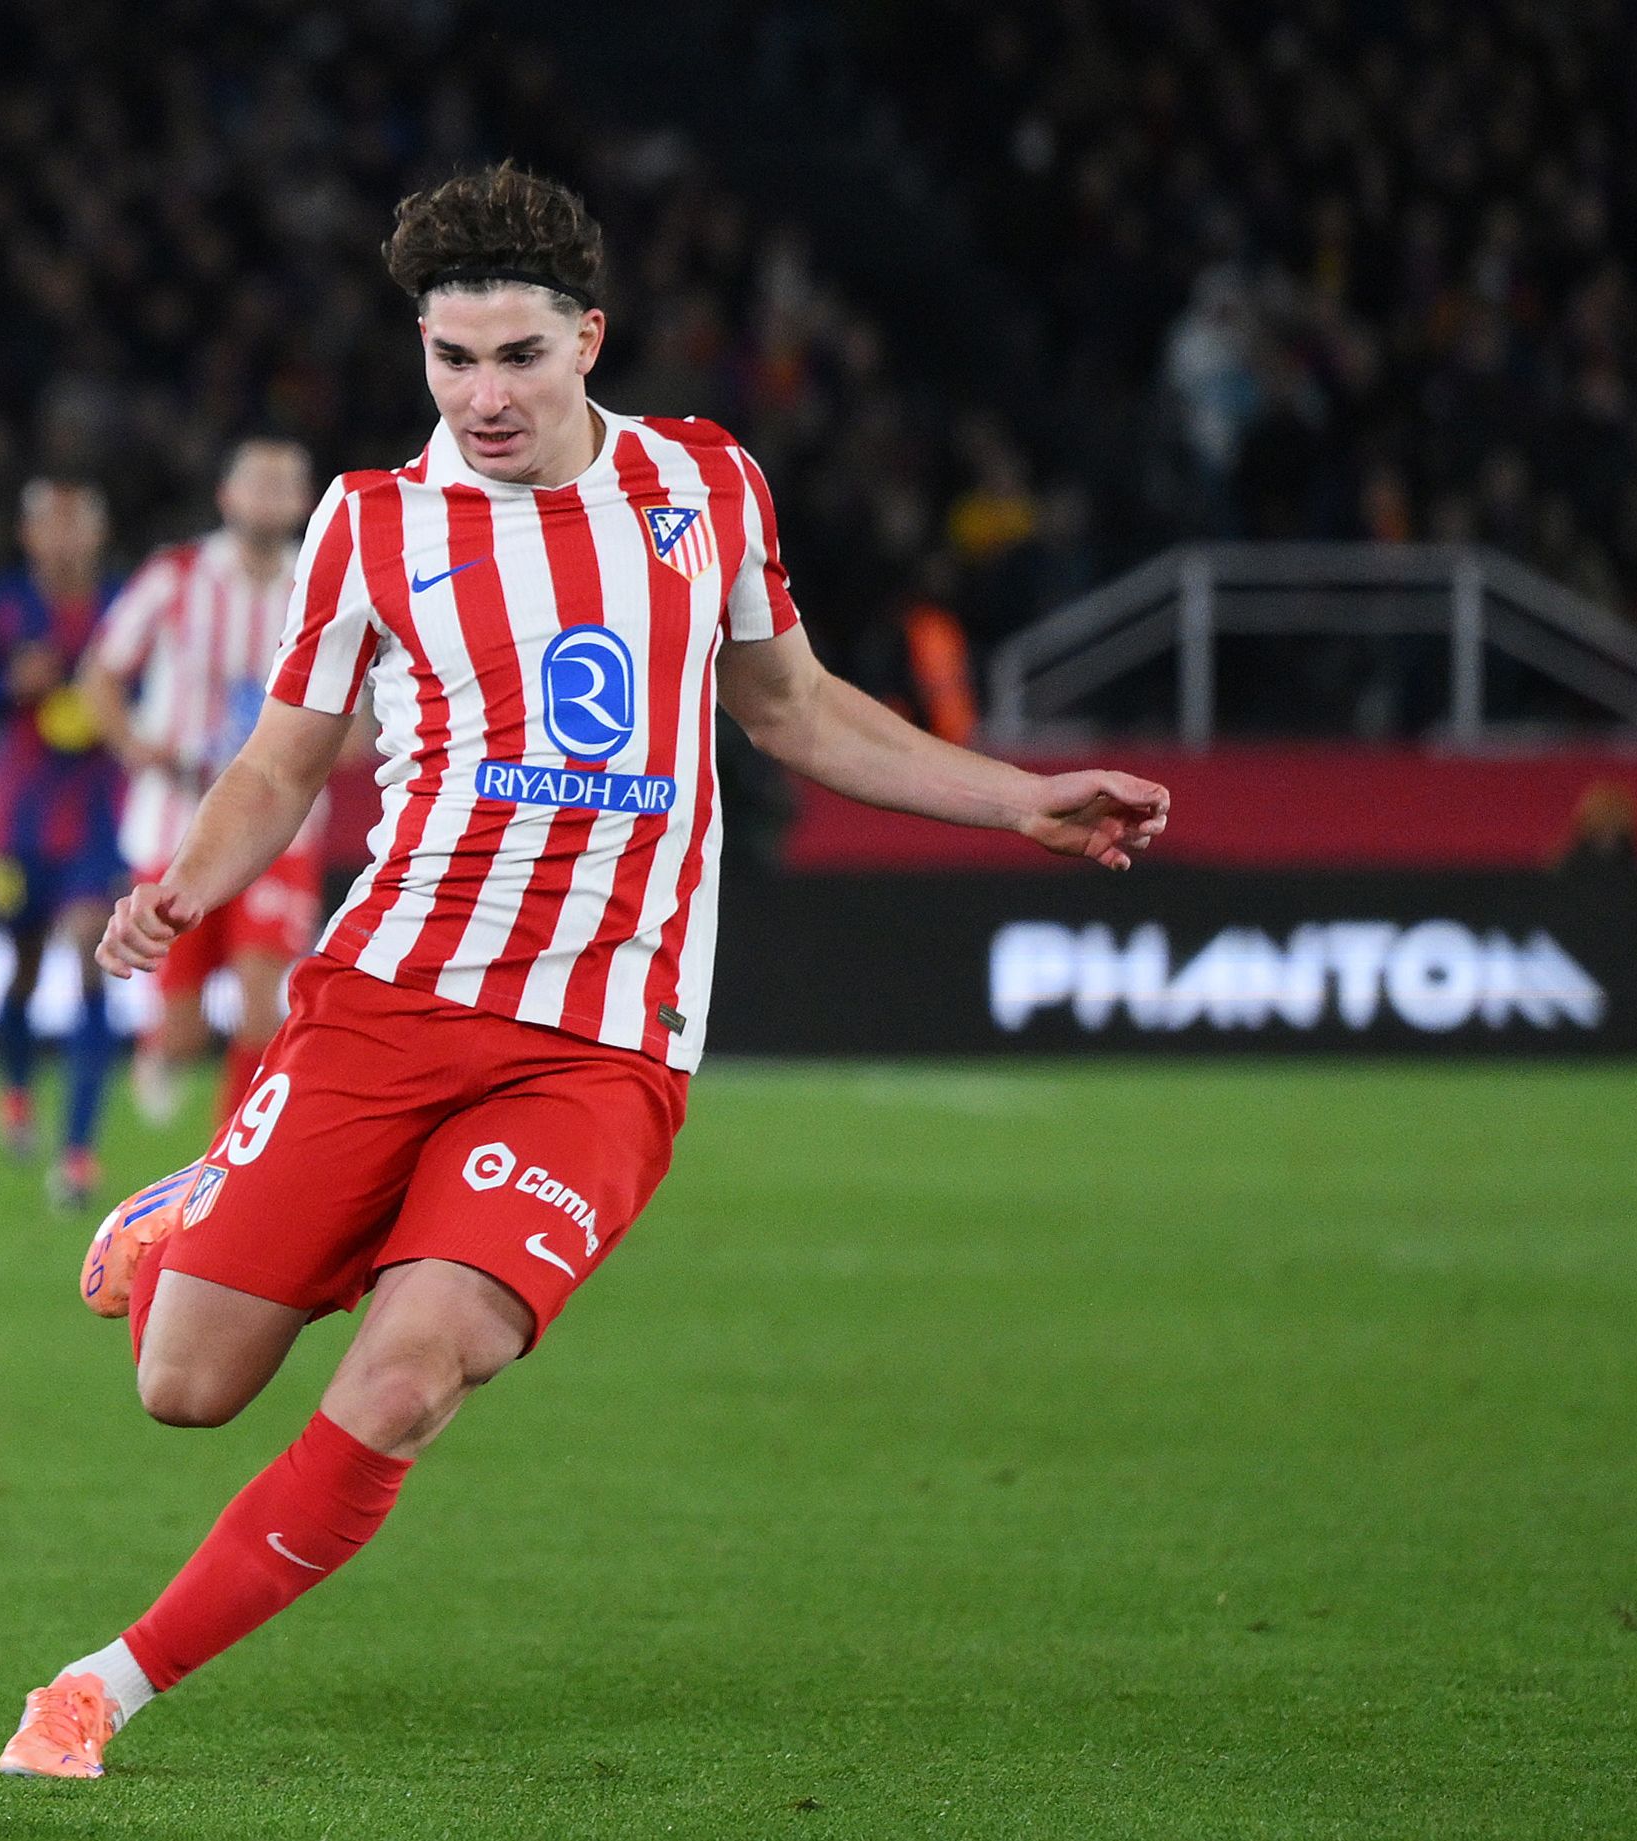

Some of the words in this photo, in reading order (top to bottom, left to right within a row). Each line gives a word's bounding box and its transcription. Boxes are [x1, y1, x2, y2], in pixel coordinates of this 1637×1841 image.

[483, 765, 613, 806] RIYADH
[619, 779, 670, 809] AIR
[989, 920, 1606, 1032] PHANTOM
